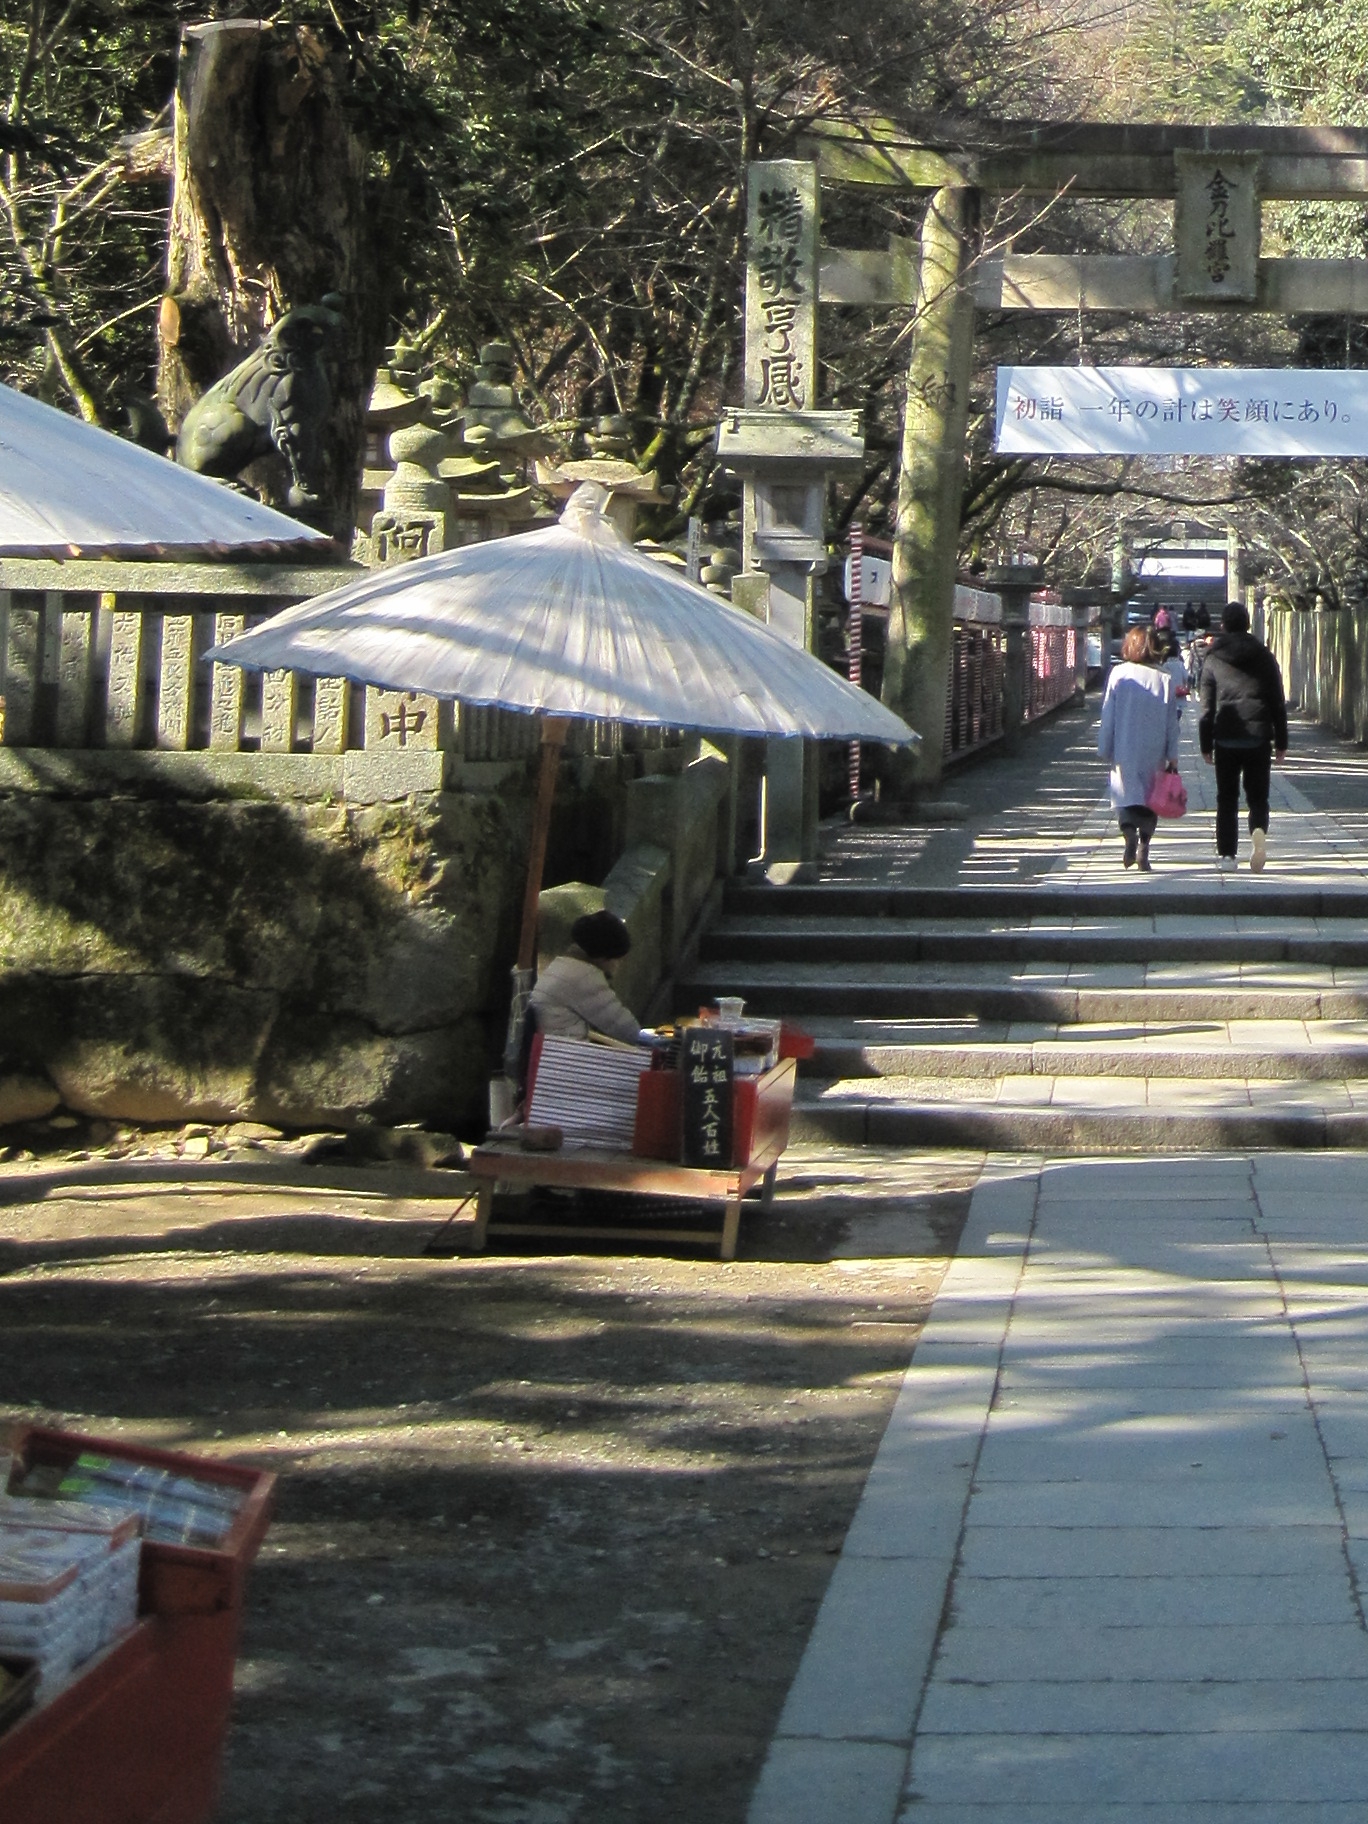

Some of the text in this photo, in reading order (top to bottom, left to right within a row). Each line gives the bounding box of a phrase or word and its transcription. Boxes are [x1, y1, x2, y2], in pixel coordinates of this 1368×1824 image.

[1013, 396, 1351, 424] 初詣 一年の計は笑顔にあり。
[711, 1039, 728, 1083] 元祖
[701, 1087, 721, 1156] 五人百姓
